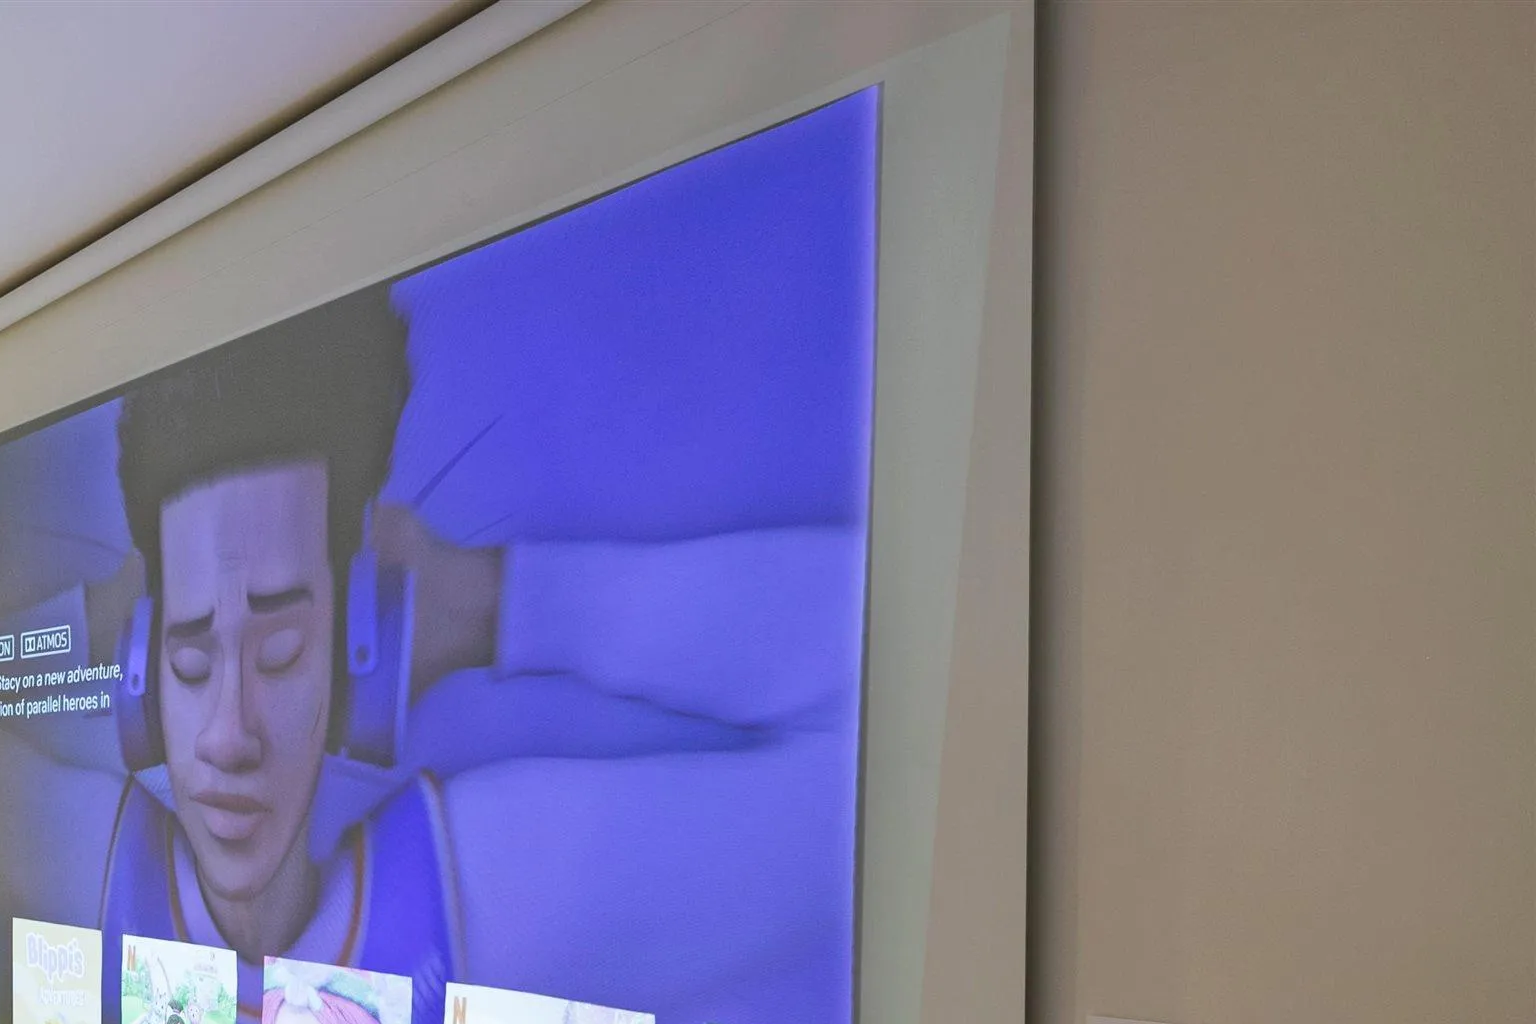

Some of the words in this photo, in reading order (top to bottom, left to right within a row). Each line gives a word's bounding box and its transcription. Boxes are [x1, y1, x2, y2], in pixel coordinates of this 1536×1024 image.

[36, 631, 67, 650] ATMOS
[23, 675, 35, 688] on
[37, 675, 44, 687] a
[44, 671, 66, 685] new
[67, 663, 123, 684] adventure,
[15, 699, 25, 715] of
[26, 695, 61, 719] parallel
[63, 695, 98, 711] heroes
[100, 691, 110, 708] in
